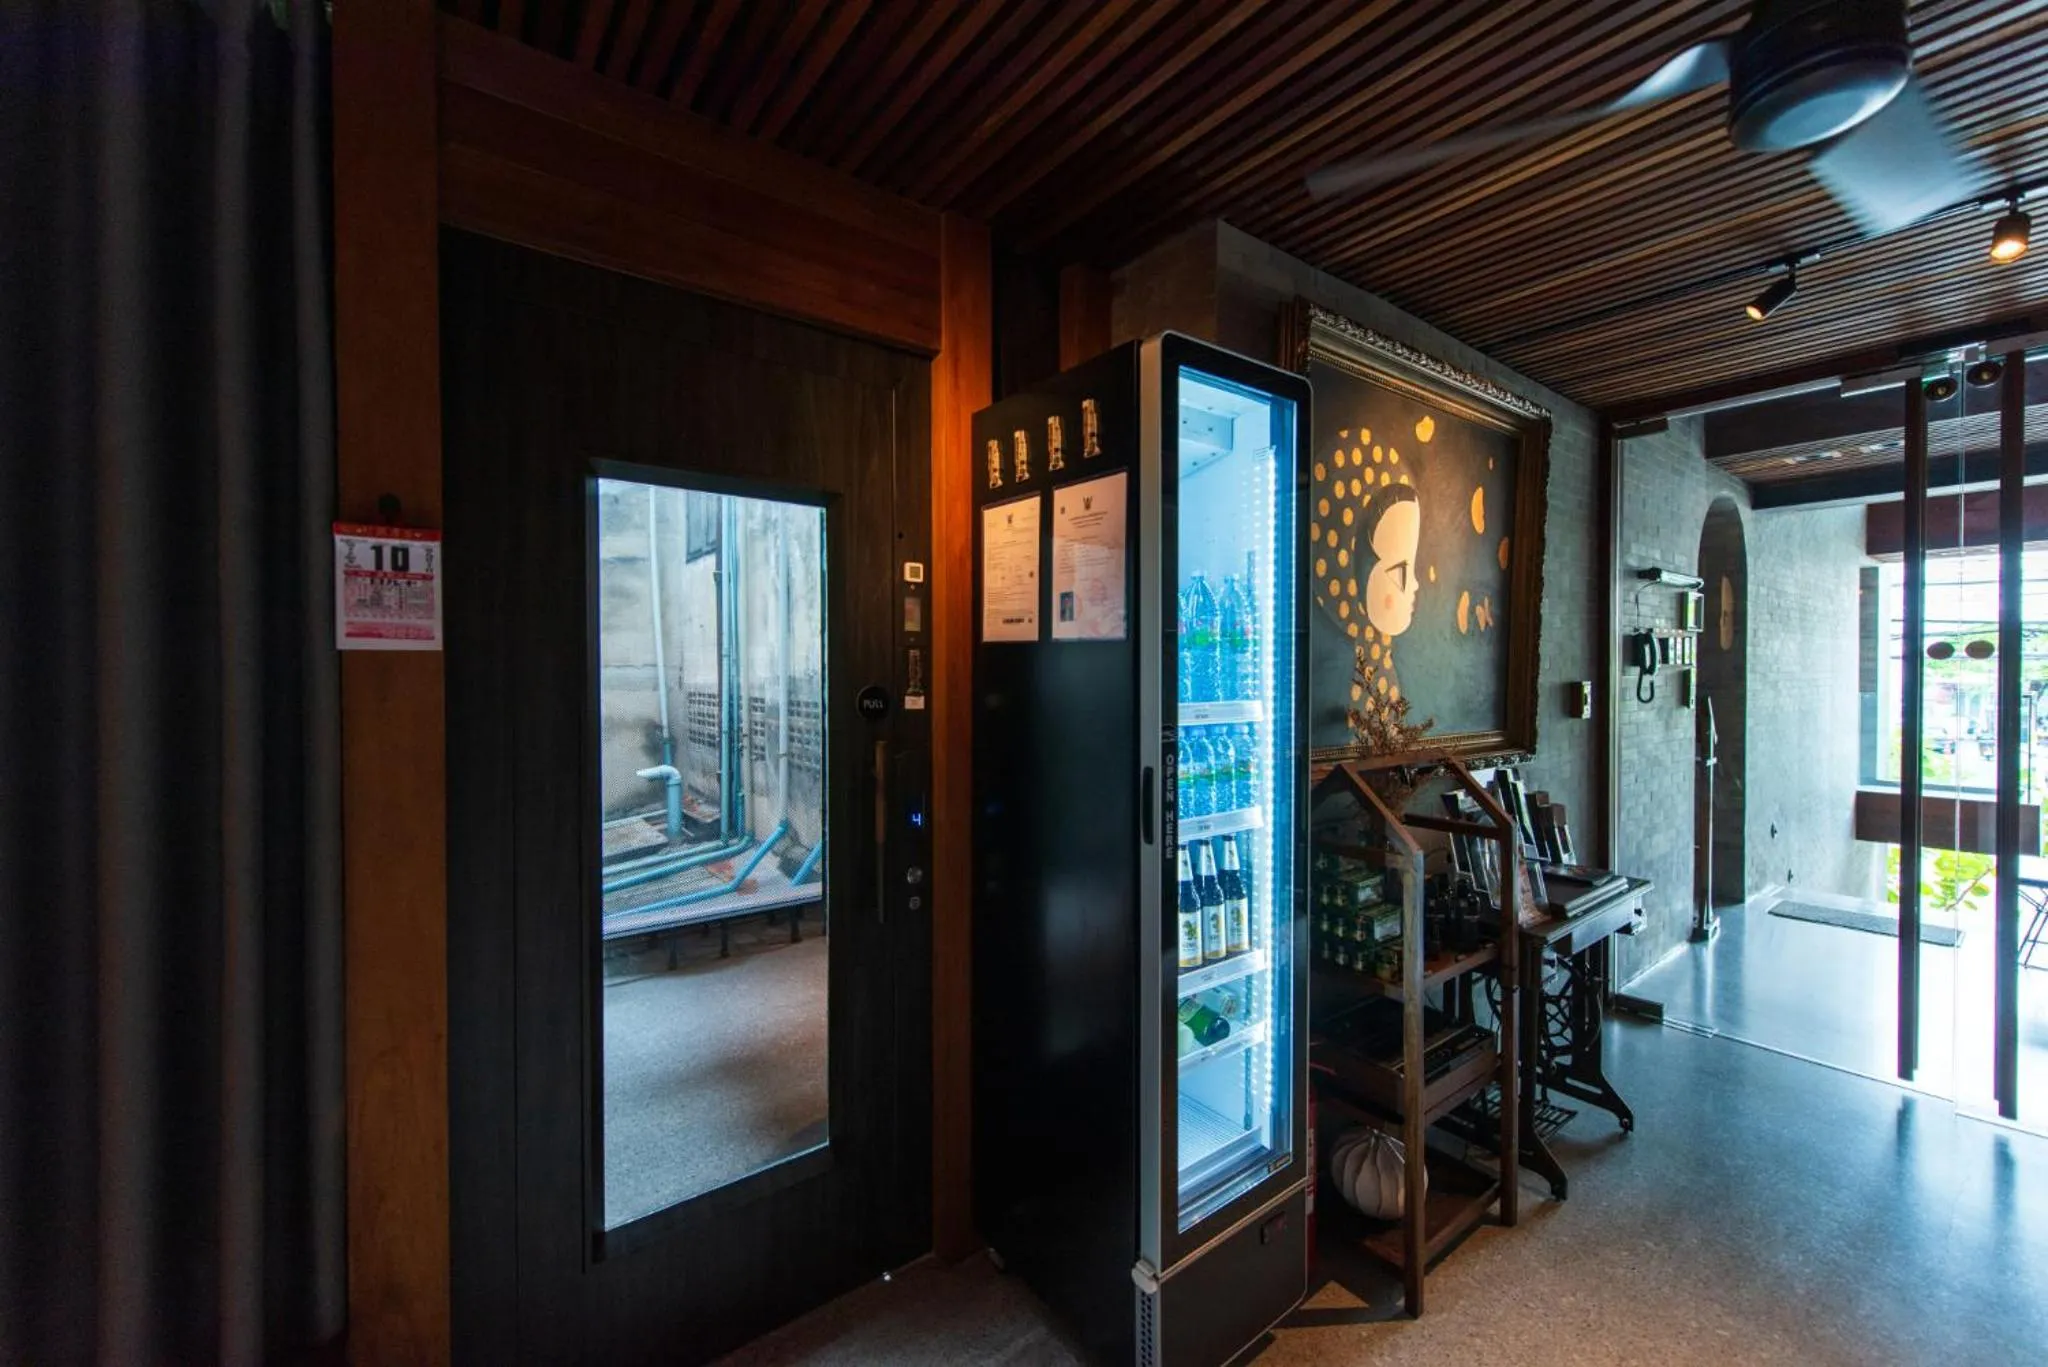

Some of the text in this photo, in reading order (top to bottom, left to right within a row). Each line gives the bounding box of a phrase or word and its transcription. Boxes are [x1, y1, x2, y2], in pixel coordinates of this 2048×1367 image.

[370, 545, 410, 572] 10
[863, 699, 884, 709] PULL
[1165, 754, 1174, 860] OPEN HERE
[912, 812, 922, 826] 4
